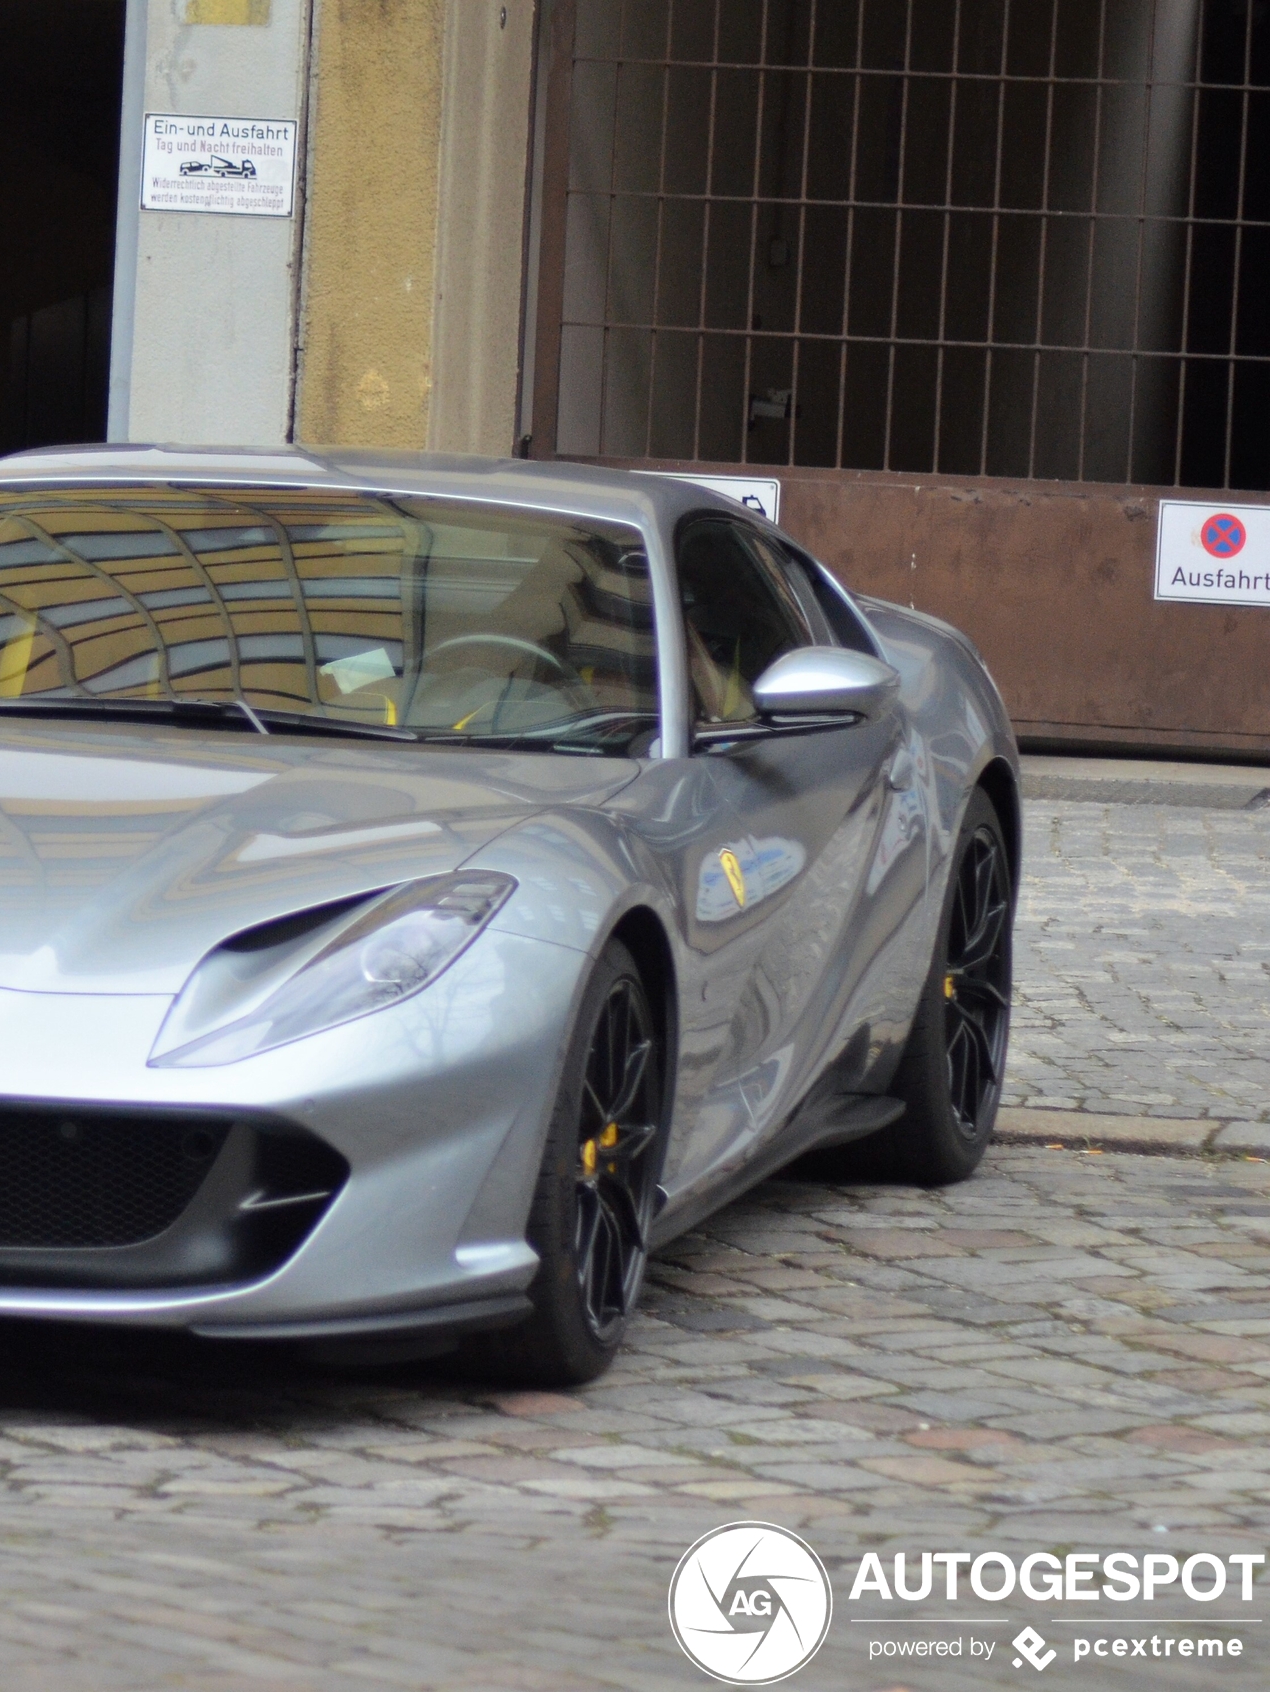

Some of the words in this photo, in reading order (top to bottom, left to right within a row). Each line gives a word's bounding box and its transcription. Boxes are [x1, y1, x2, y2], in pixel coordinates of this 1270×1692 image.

[220, 123, 289, 140] Ausfahrt
[156, 138, 173, 154] Tag
[177, 139, 197, 152] und
[200, 140, 230, 154] Nacht
[232, 142, 283, 157] freihalten
[152, 177, 205, 190] Widerrechtlich
[247, 182, 284, 197] Fahrzeuge
[150, 192, 178, 203] werden
[180, 193, 234, 209] kostenpflichtig
[236, 196, 284, 211] abgeschleppt
[1171, 566, 1270, 591] Ausfahrt
